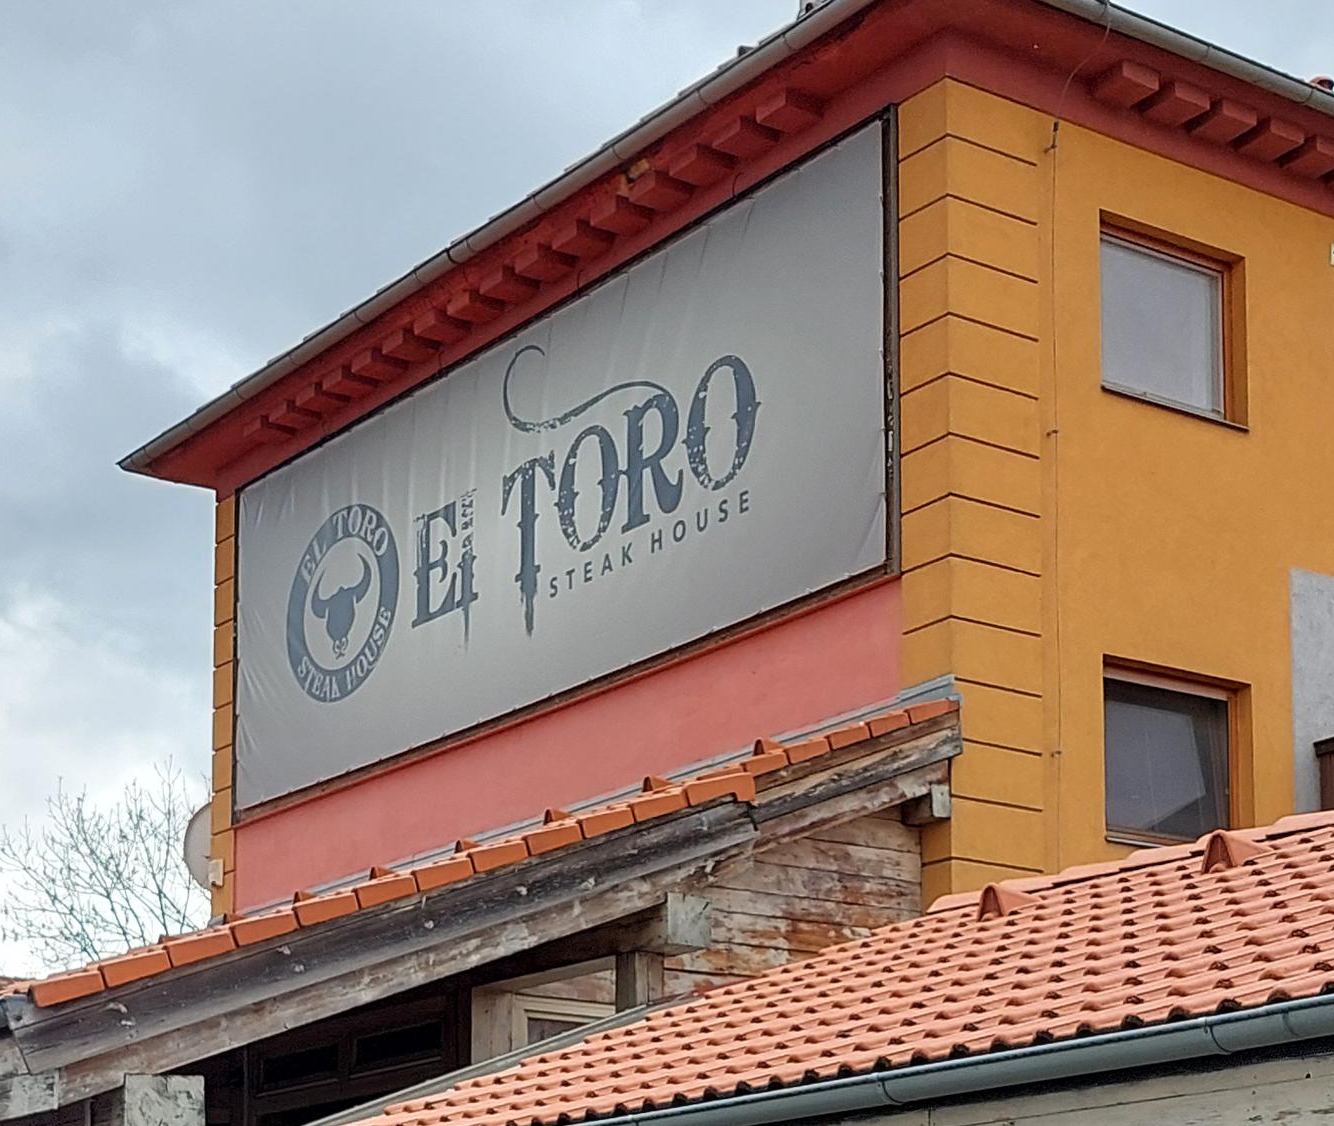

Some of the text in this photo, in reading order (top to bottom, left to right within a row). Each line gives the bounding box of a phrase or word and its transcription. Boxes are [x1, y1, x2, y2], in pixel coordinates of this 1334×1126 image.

[501, 352, 762, 634] TORO
[301, 506, 389, 584] EL TORO
[549, 490, 749, 598] STEAK HOUSE
[298, 606, 391, 699] STEAK HOUSE
